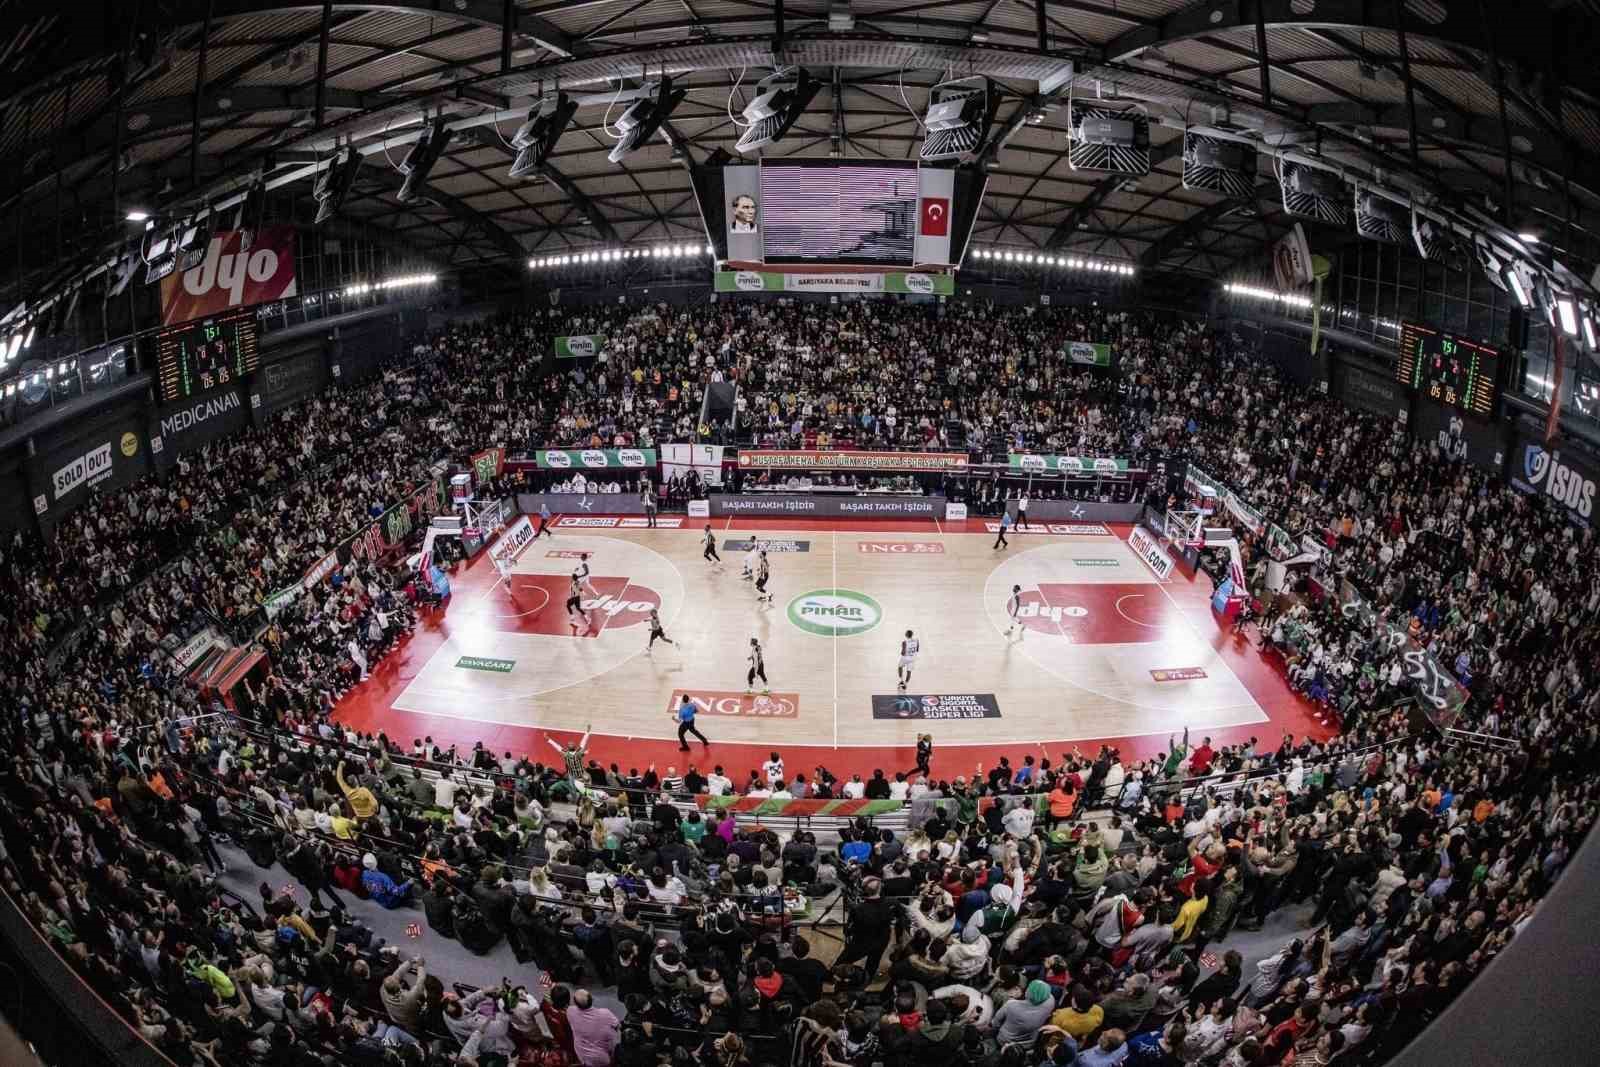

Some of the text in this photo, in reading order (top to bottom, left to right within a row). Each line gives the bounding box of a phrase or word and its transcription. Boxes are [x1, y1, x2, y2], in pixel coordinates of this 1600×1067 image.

[183, 237, 279, 306] dyo
[57, 464, 83, 490] SOLD
[88, 450, 107, 471] OUT
[721, 500, 815, 510] BAŞARI TAKIM İŞİDİR
[840, 502, 933, 512] BAŞARI TAKIM İŞİDİR
[859, 543, 908, 553] ING
[1132, 533, 1167, 575] misli.com
[579, 595, 656, 616] dyo
[1017, 601, 1089, 622] dyo
[672, 695, 742, 714] ING
